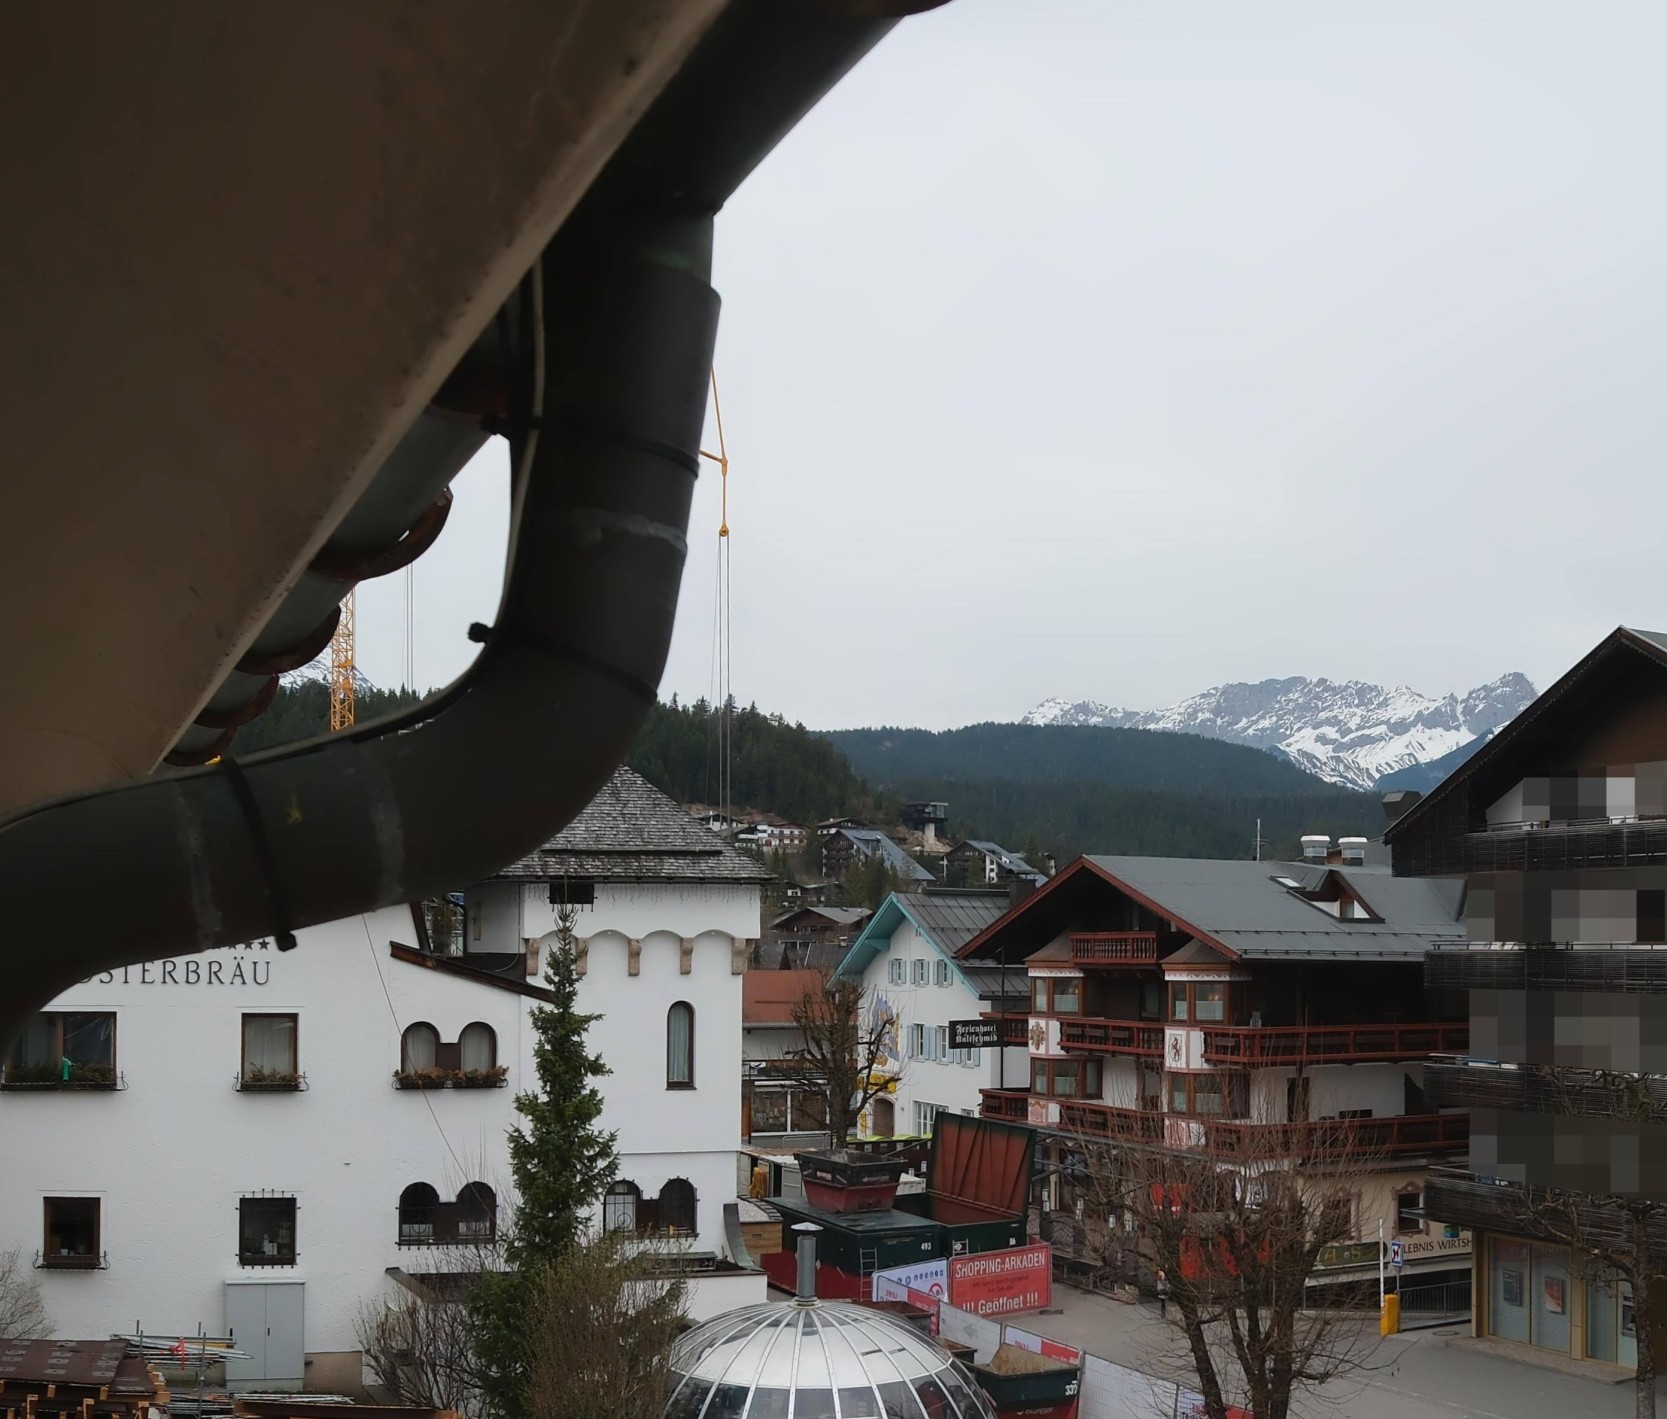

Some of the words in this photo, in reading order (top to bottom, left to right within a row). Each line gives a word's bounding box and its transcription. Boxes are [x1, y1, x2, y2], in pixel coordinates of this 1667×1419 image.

[79, 956, 271, 985] STERBRÄU
[921, 1241, 932, 1251] 493
[955, 1252, 1045, 1278] SHOPPING-ARKADEN
[978, 1295, 1024, 1315] Geöffnet
